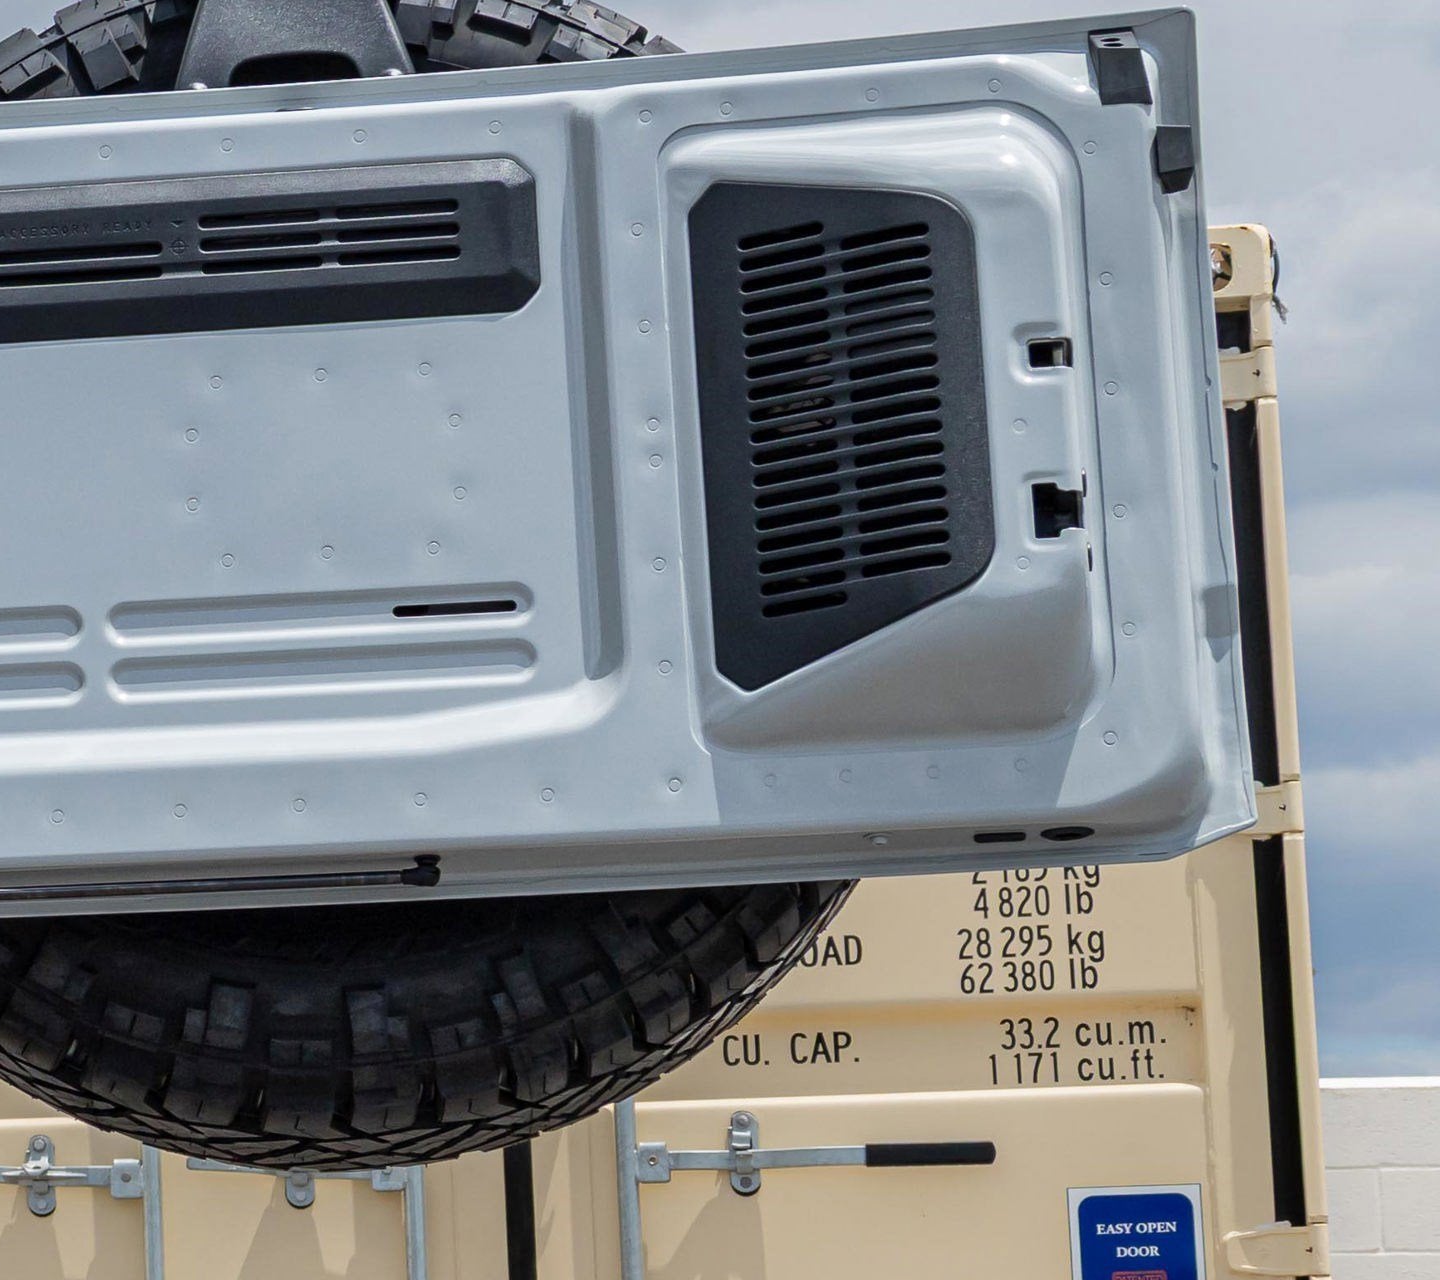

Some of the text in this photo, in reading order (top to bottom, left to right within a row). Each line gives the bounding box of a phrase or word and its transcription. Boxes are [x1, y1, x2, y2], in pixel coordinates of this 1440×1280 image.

[101, 219, 153, 235] READY
[1065, 884, 1094, 915] lb
[1067, 924, 1106, 963] kg
[1069, 958, 1099, 990] lb
[722, 1031, 861, 1067] CU. CAP.
[999, 1017, 1061, 1050] 33.2
[1096, 1221, 1177, 1235] EASY OPEN
[1116, 1245, 1160, 1258] DOOR
